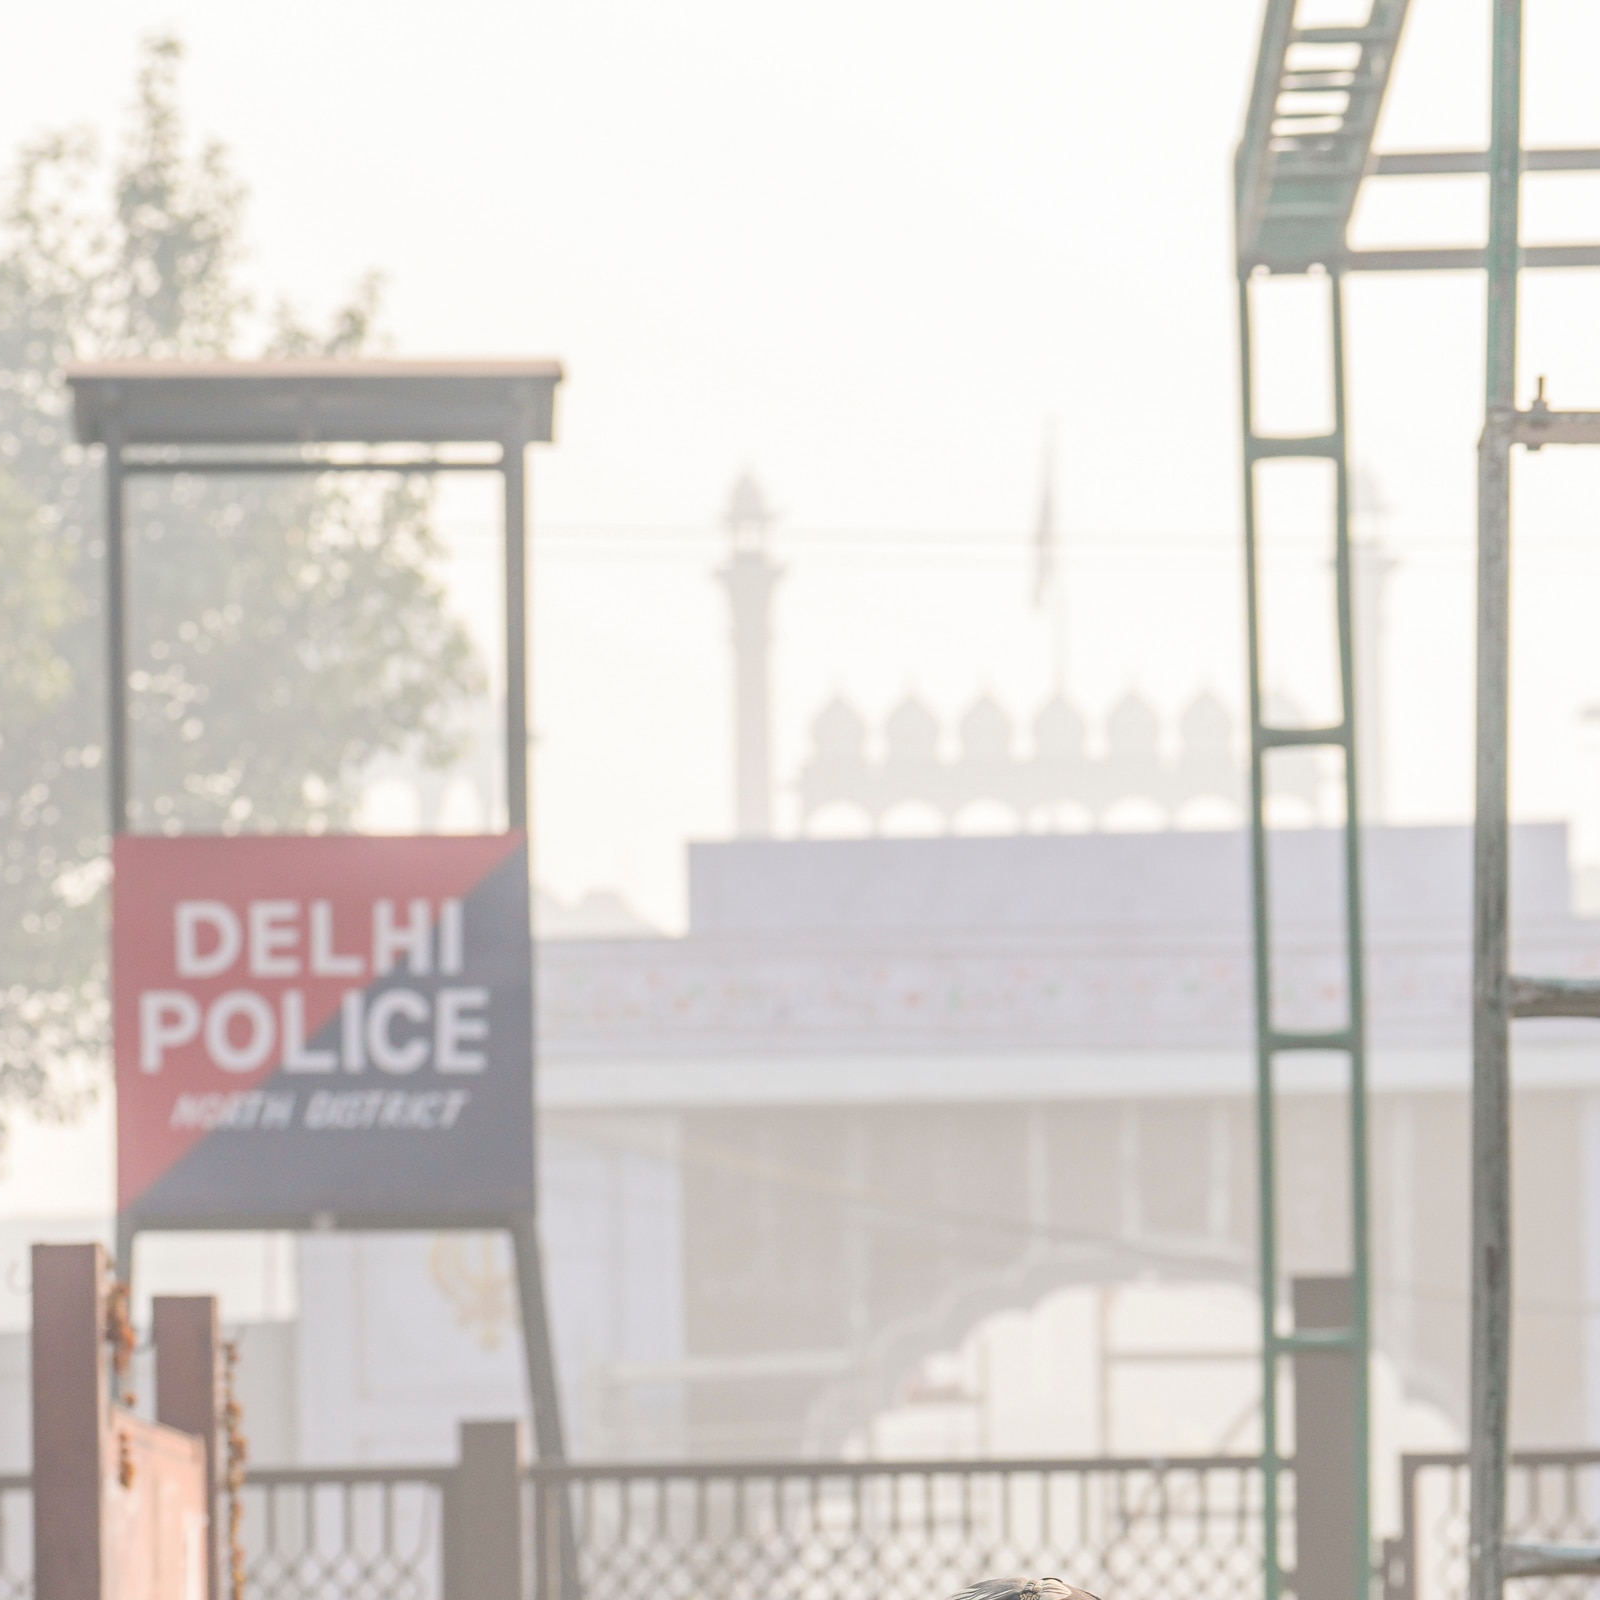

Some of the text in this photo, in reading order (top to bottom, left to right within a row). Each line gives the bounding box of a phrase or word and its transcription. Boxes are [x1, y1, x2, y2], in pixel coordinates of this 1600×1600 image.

[174, 900, 465, 979] DELHI
[138, 988, 491, 1075] POLICE
[169, 1089, 469, 1131] NORTH DISTRICT
